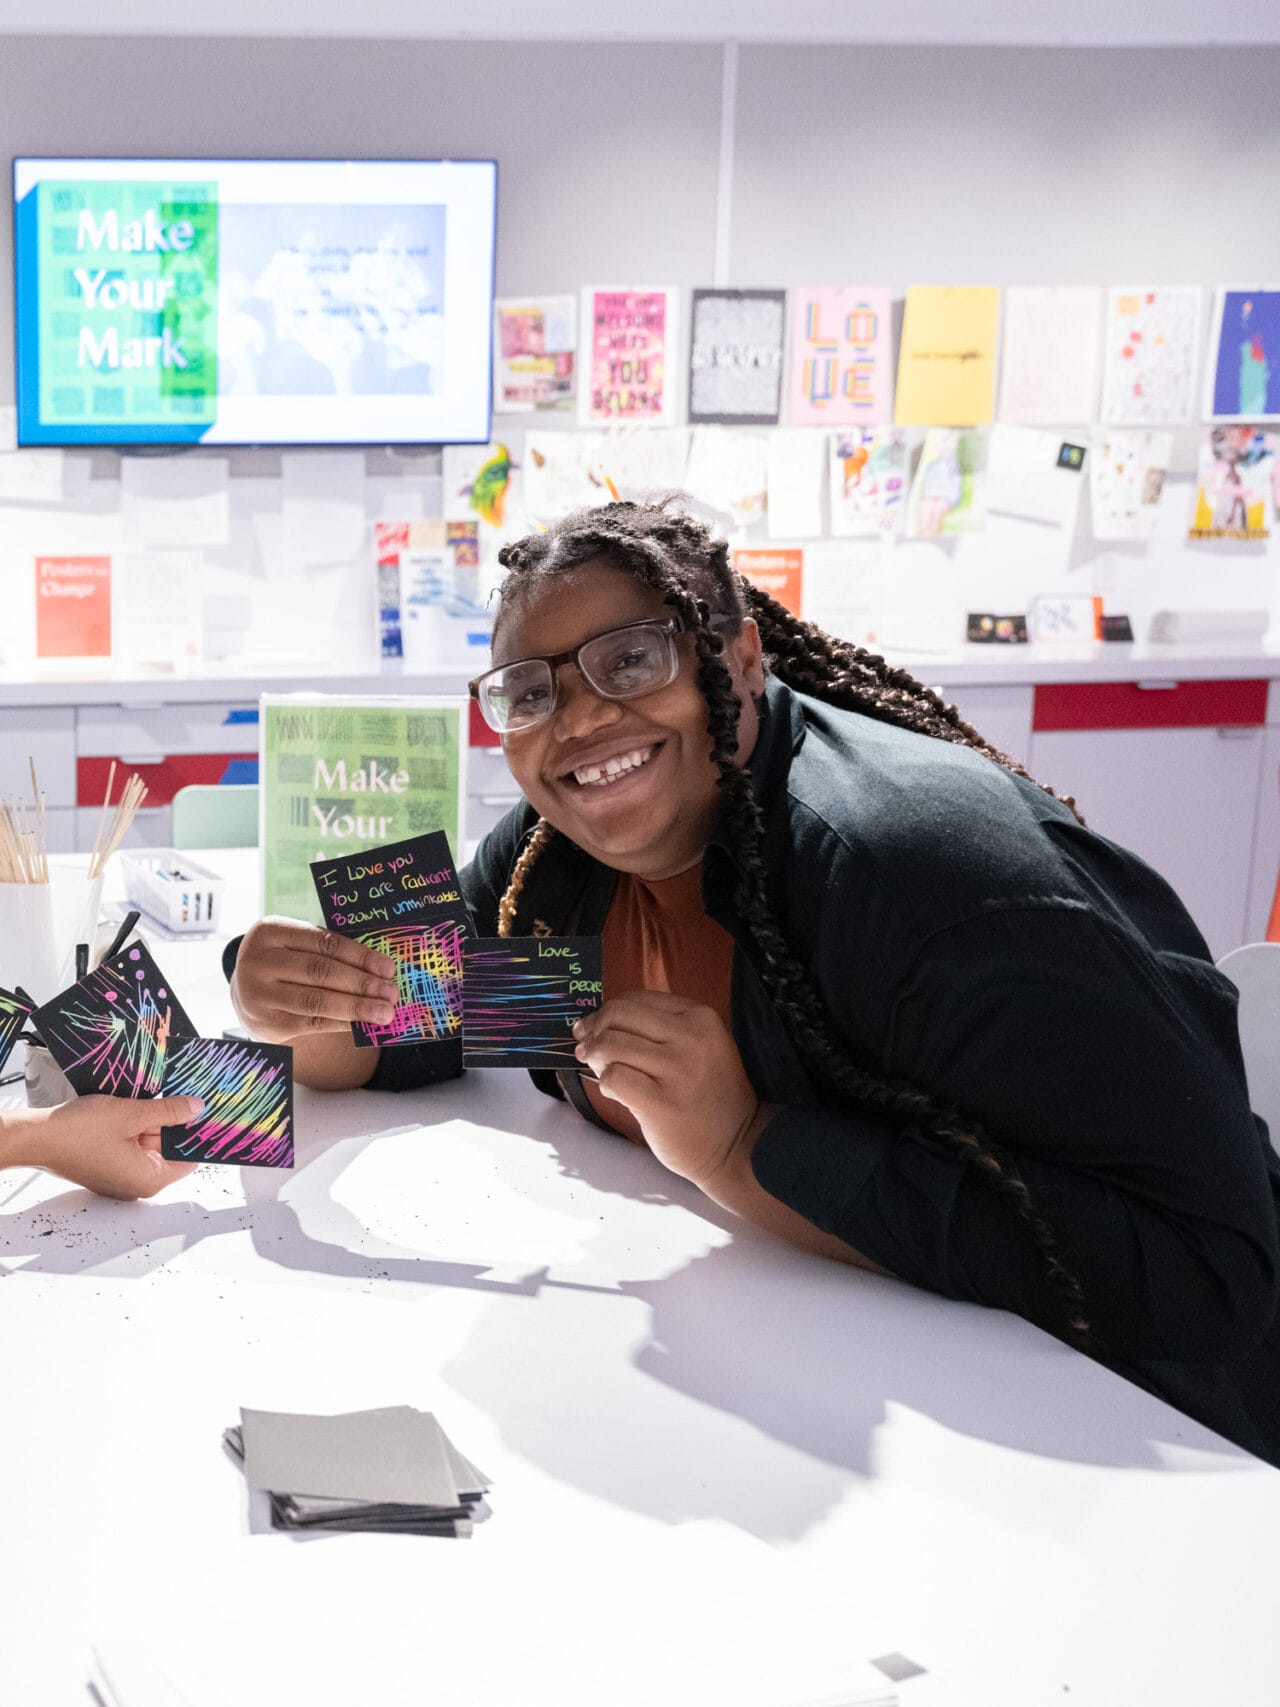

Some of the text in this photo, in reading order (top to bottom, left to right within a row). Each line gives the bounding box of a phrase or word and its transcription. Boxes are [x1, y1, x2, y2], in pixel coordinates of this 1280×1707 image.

[77, 208, 194, 251] Make
[74, 267, 175, 311] Your
[77, 326, 187, 369] Mark
[313, 759, 410, 793] Make
[312, 804, 393, 840] Your
[318, 853, 414, 889] I Love you
[369, 881, 394, 898] are
[401, 868, 453, 891] radiant
[330, 889, 461, 928] Beauty unthinkable
[538, 942, 580, 957] Love
[575, 996, 598, 1008] and
